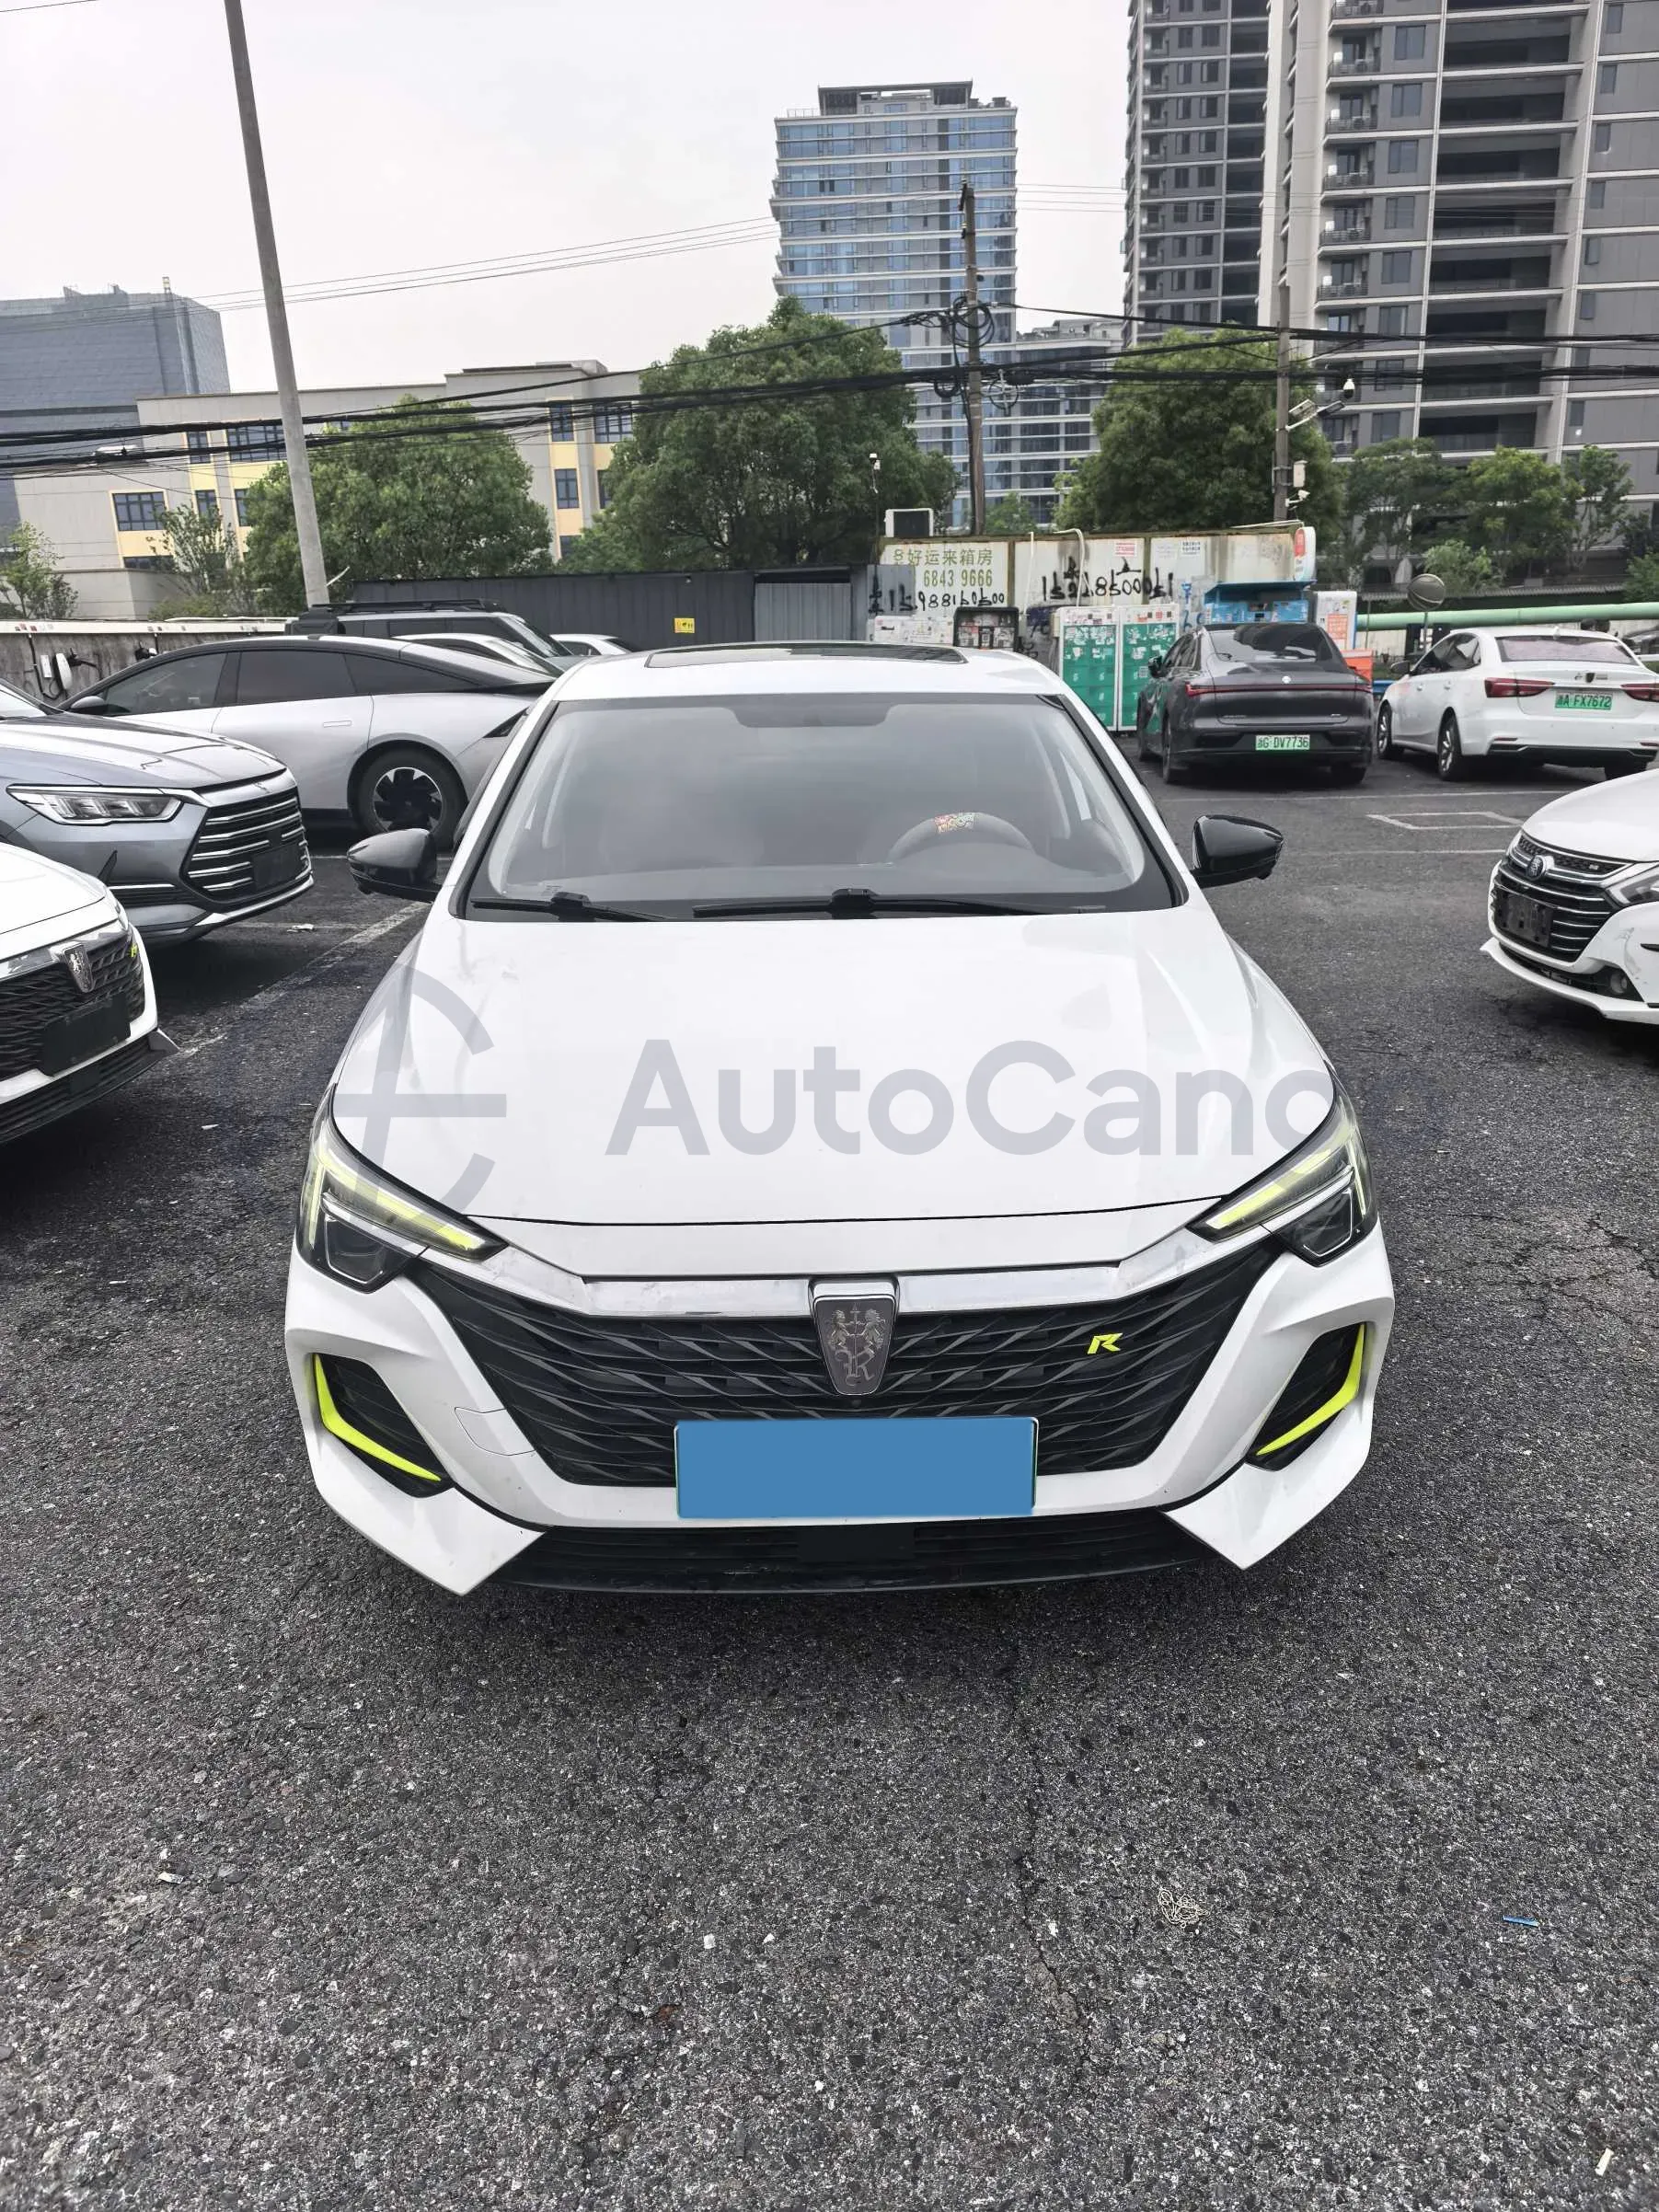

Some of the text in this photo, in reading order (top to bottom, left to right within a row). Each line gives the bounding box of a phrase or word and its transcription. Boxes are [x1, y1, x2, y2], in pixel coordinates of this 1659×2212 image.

[908, 548, 993, 566] 好运来箱房
[924, 570, 993, 587] 6843 9666
